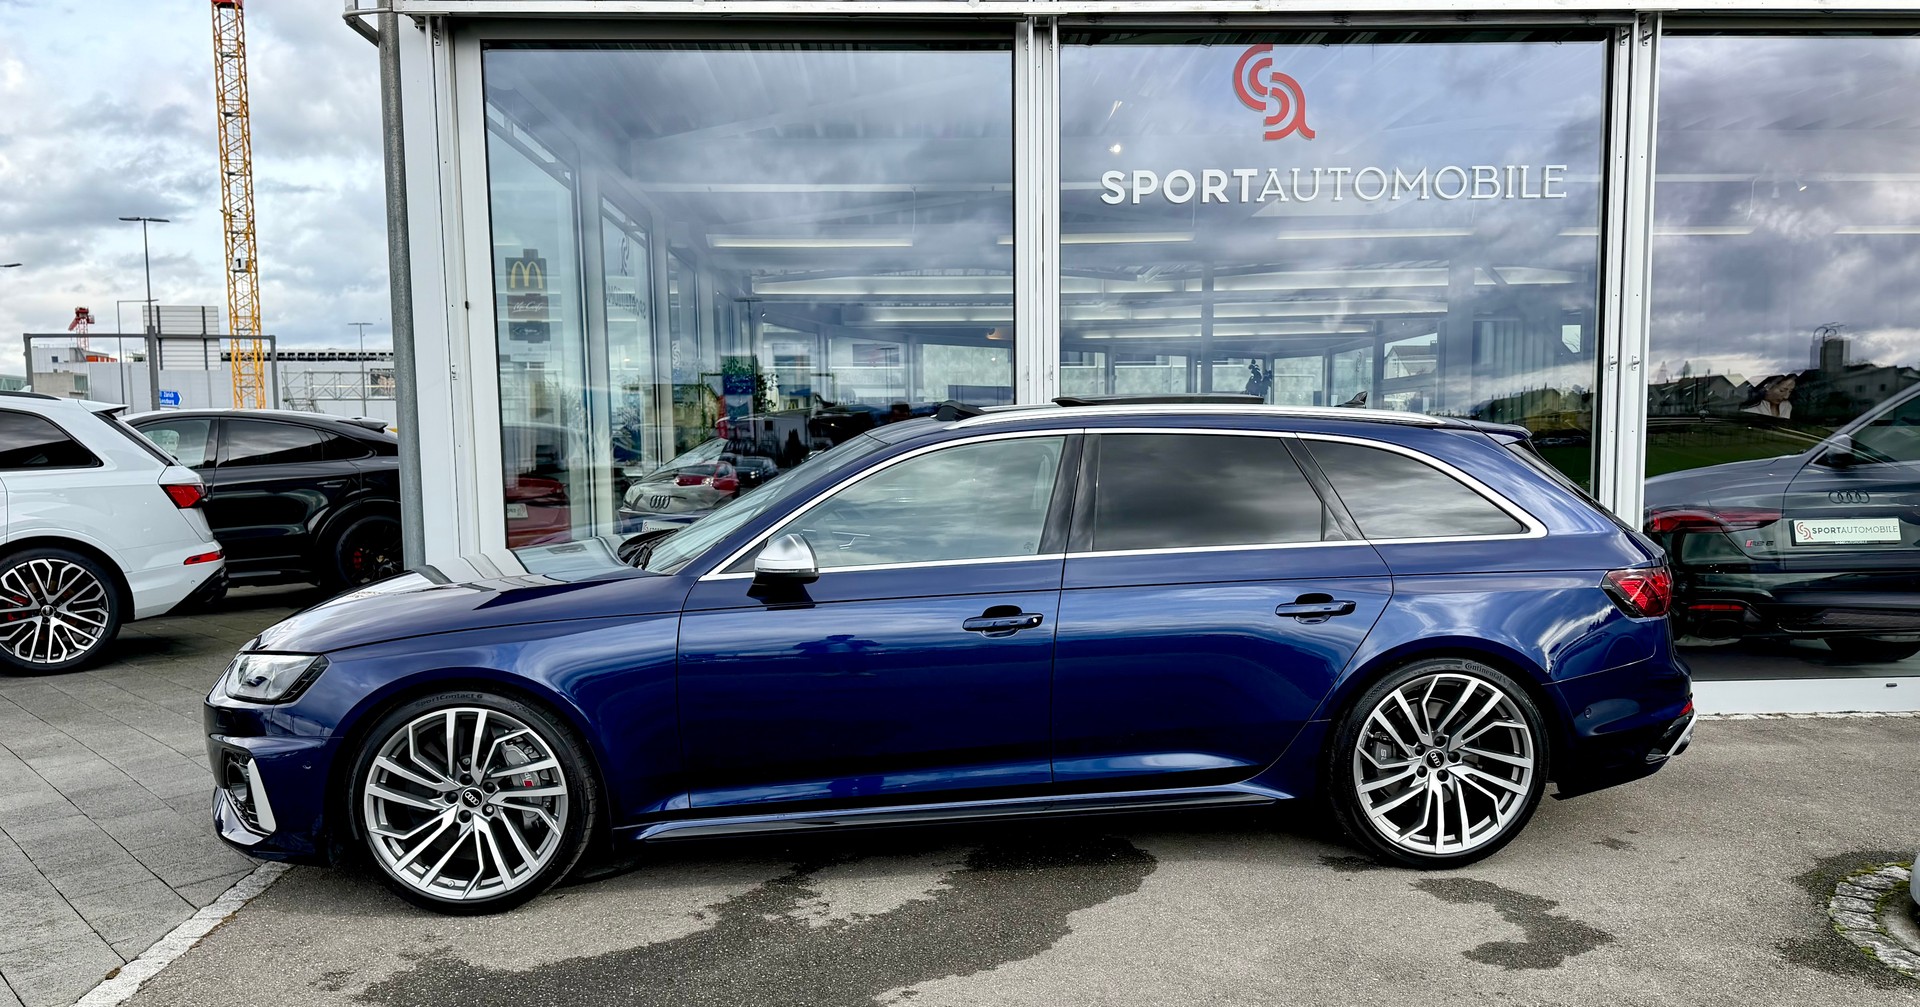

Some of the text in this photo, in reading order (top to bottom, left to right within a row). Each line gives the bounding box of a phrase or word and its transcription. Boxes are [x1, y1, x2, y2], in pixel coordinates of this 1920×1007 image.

[1100, 164, 1567, 205] SPORTAUTOMOBILE
[235, 258, 241, 268] 1
[1812, 525, 1899, 535] SPORTAUTOMOBILE
[1464, 662, 1503, 682] Continental
